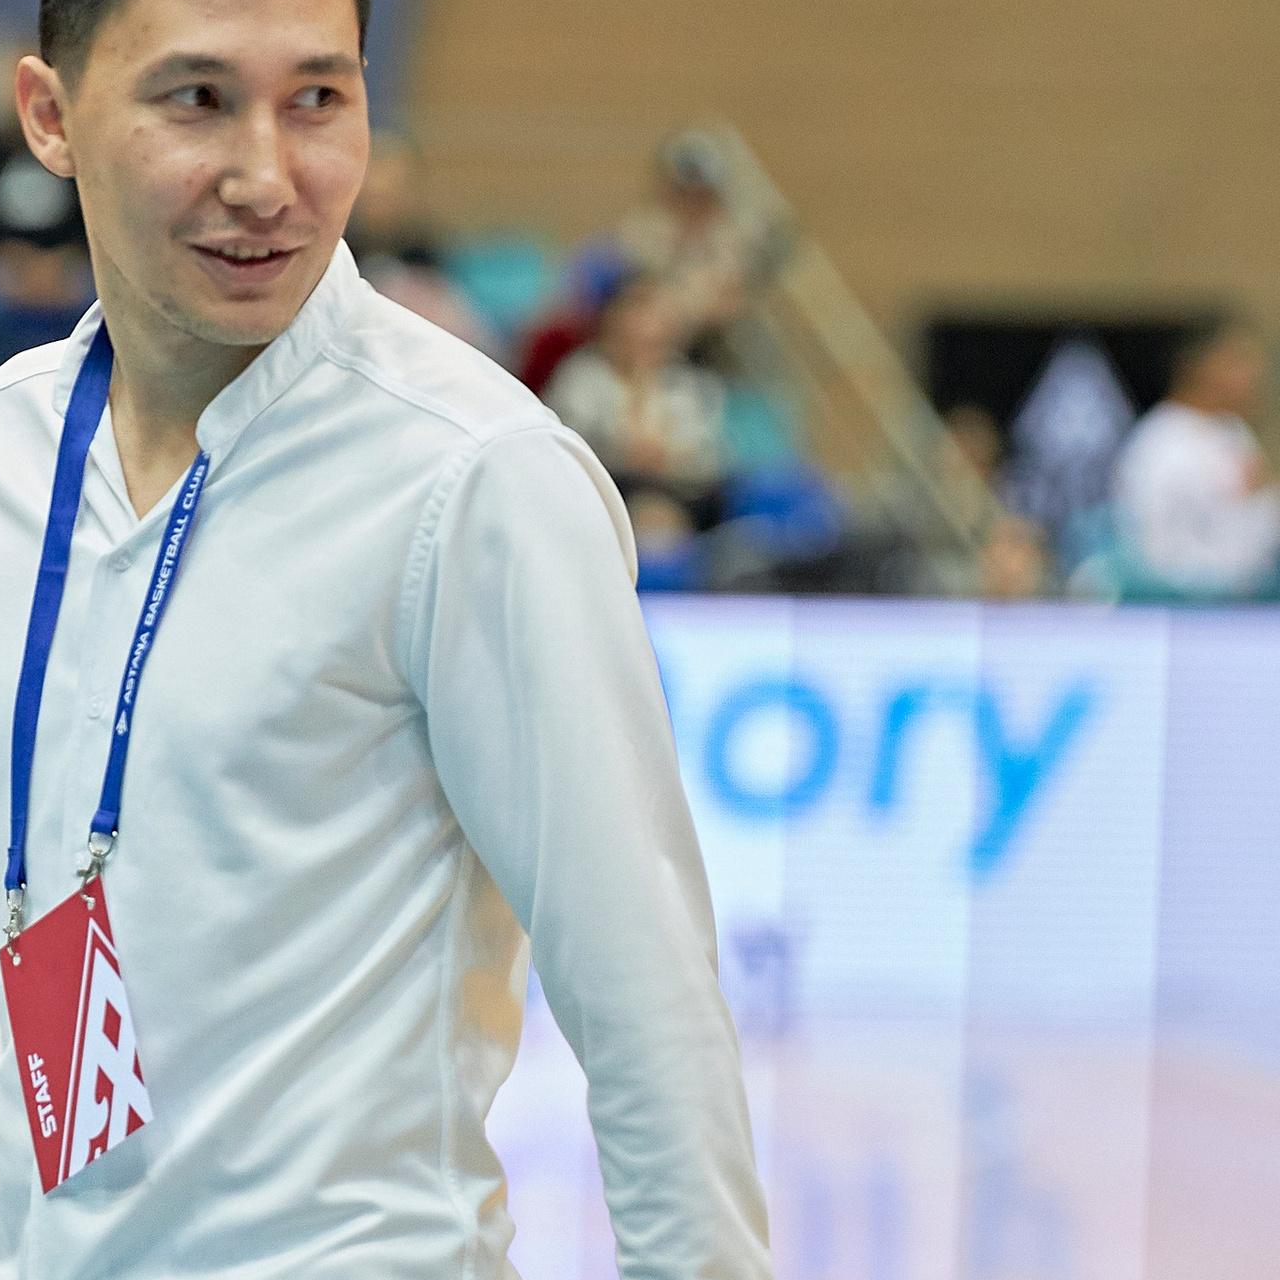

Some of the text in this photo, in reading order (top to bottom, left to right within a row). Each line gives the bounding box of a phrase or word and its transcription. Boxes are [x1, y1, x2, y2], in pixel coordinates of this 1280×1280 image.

[123, 464, 206, 704] ASTANA BASKETBALL CLUB
[672, 668, 1105, 880] ory
[27, 1053, 58, 1138] STAFF
